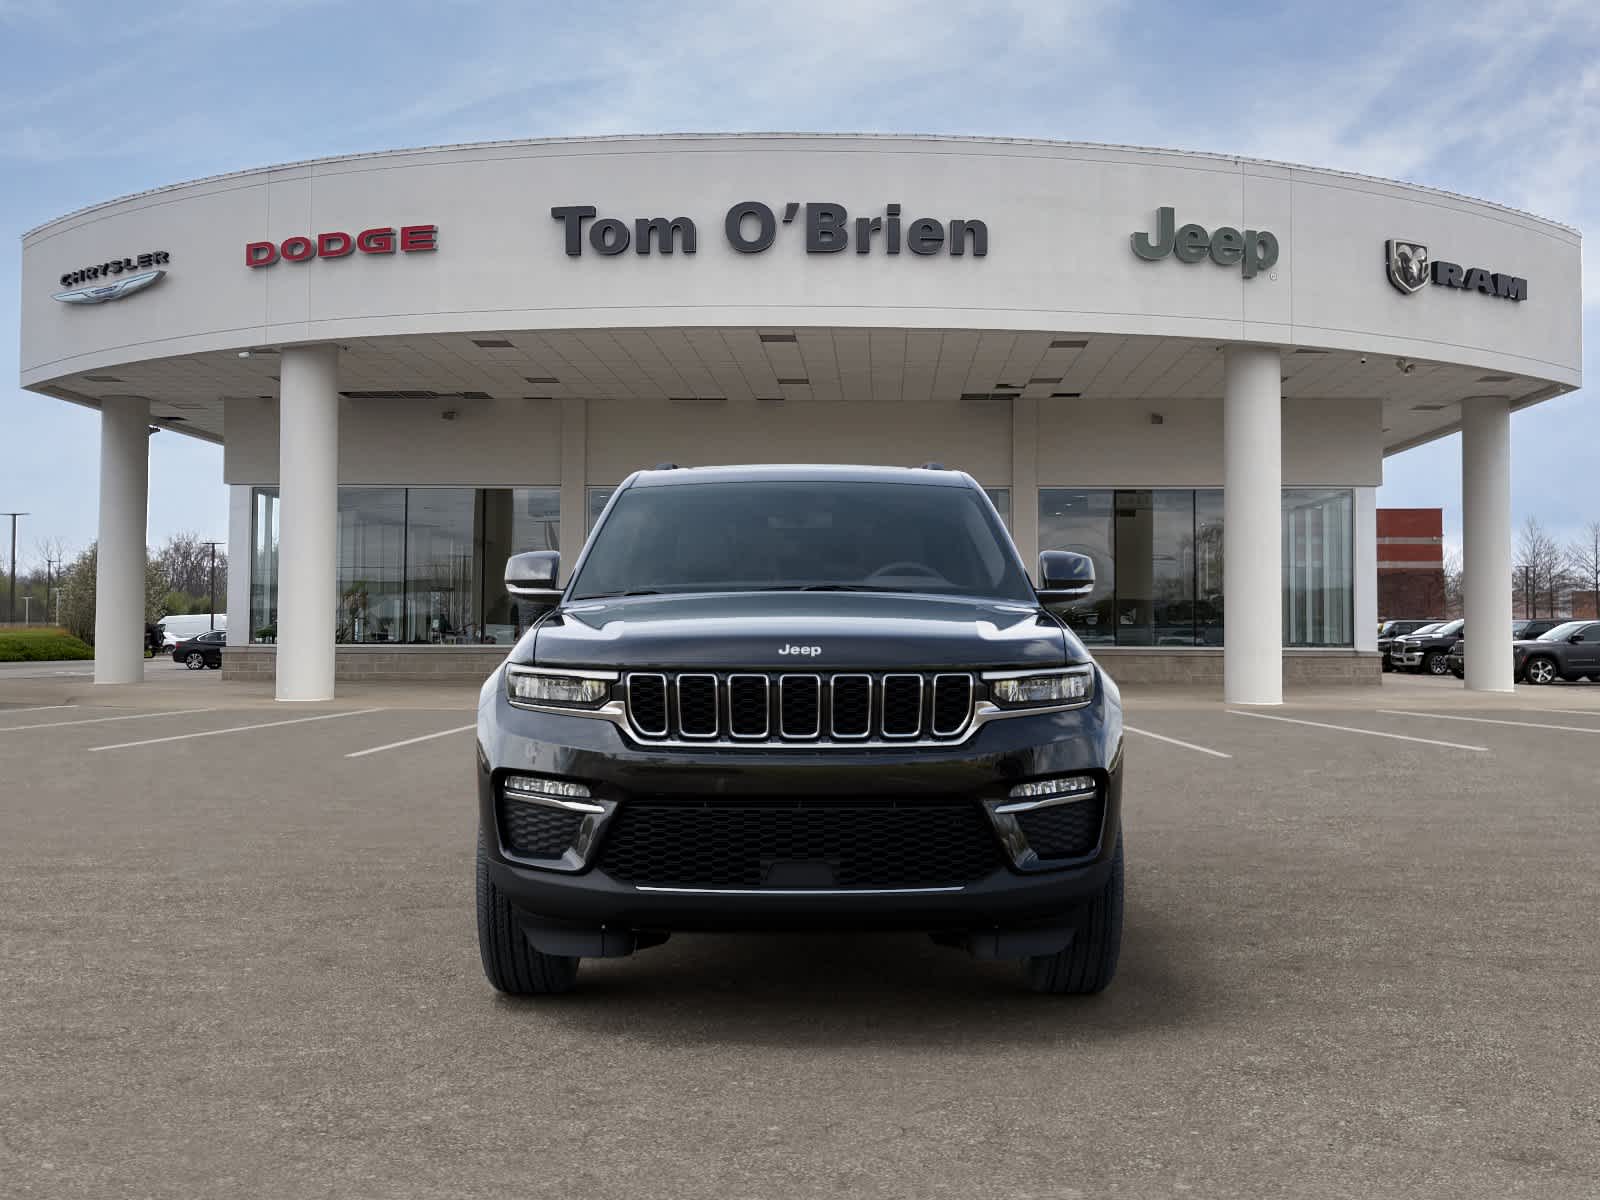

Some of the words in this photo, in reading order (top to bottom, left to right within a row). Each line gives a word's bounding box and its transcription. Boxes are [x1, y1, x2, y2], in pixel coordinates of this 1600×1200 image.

[245, 225, 438, 269] DODGE
[551, 204, 697, 257] Tom
[725, 200, 988, 256] O'Brien
[1130, 206, 1279, 279] Jeep
[60, 250, 170, 287] CHRYSLER
[1431, 260, 1528, 301] RAM
[778, 643, 822, 657] Jeep
